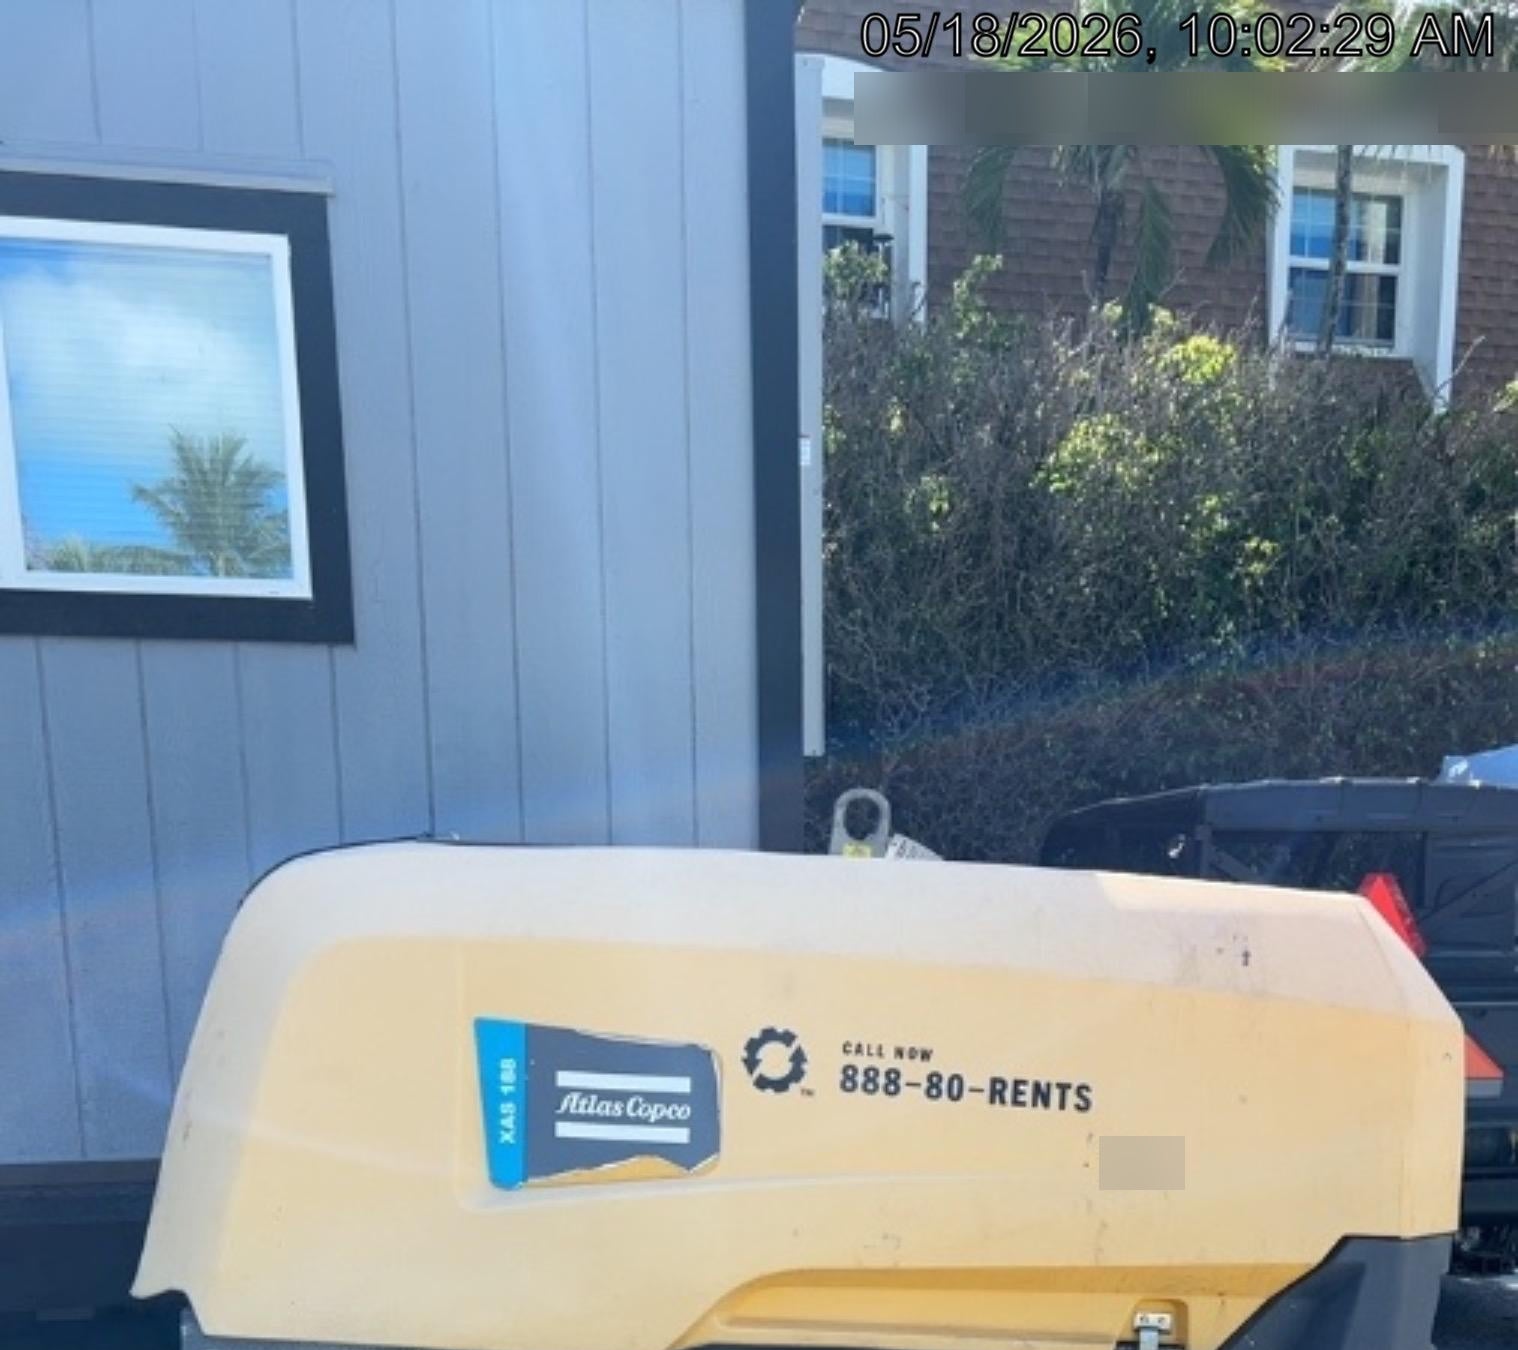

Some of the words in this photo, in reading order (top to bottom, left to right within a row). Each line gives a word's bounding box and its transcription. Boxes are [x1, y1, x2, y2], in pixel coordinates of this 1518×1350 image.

[843, 1040, 886, 1059] CALL
[894, 1046, 933, 1062] NOW
[840, 1064, 1093, 1112] 888-80-RENTS
[500, 1103, 517, 1144] XAS
[555, 1091, 624, 1117] Atlas
[626, 1095, 691, 1123] Copco
